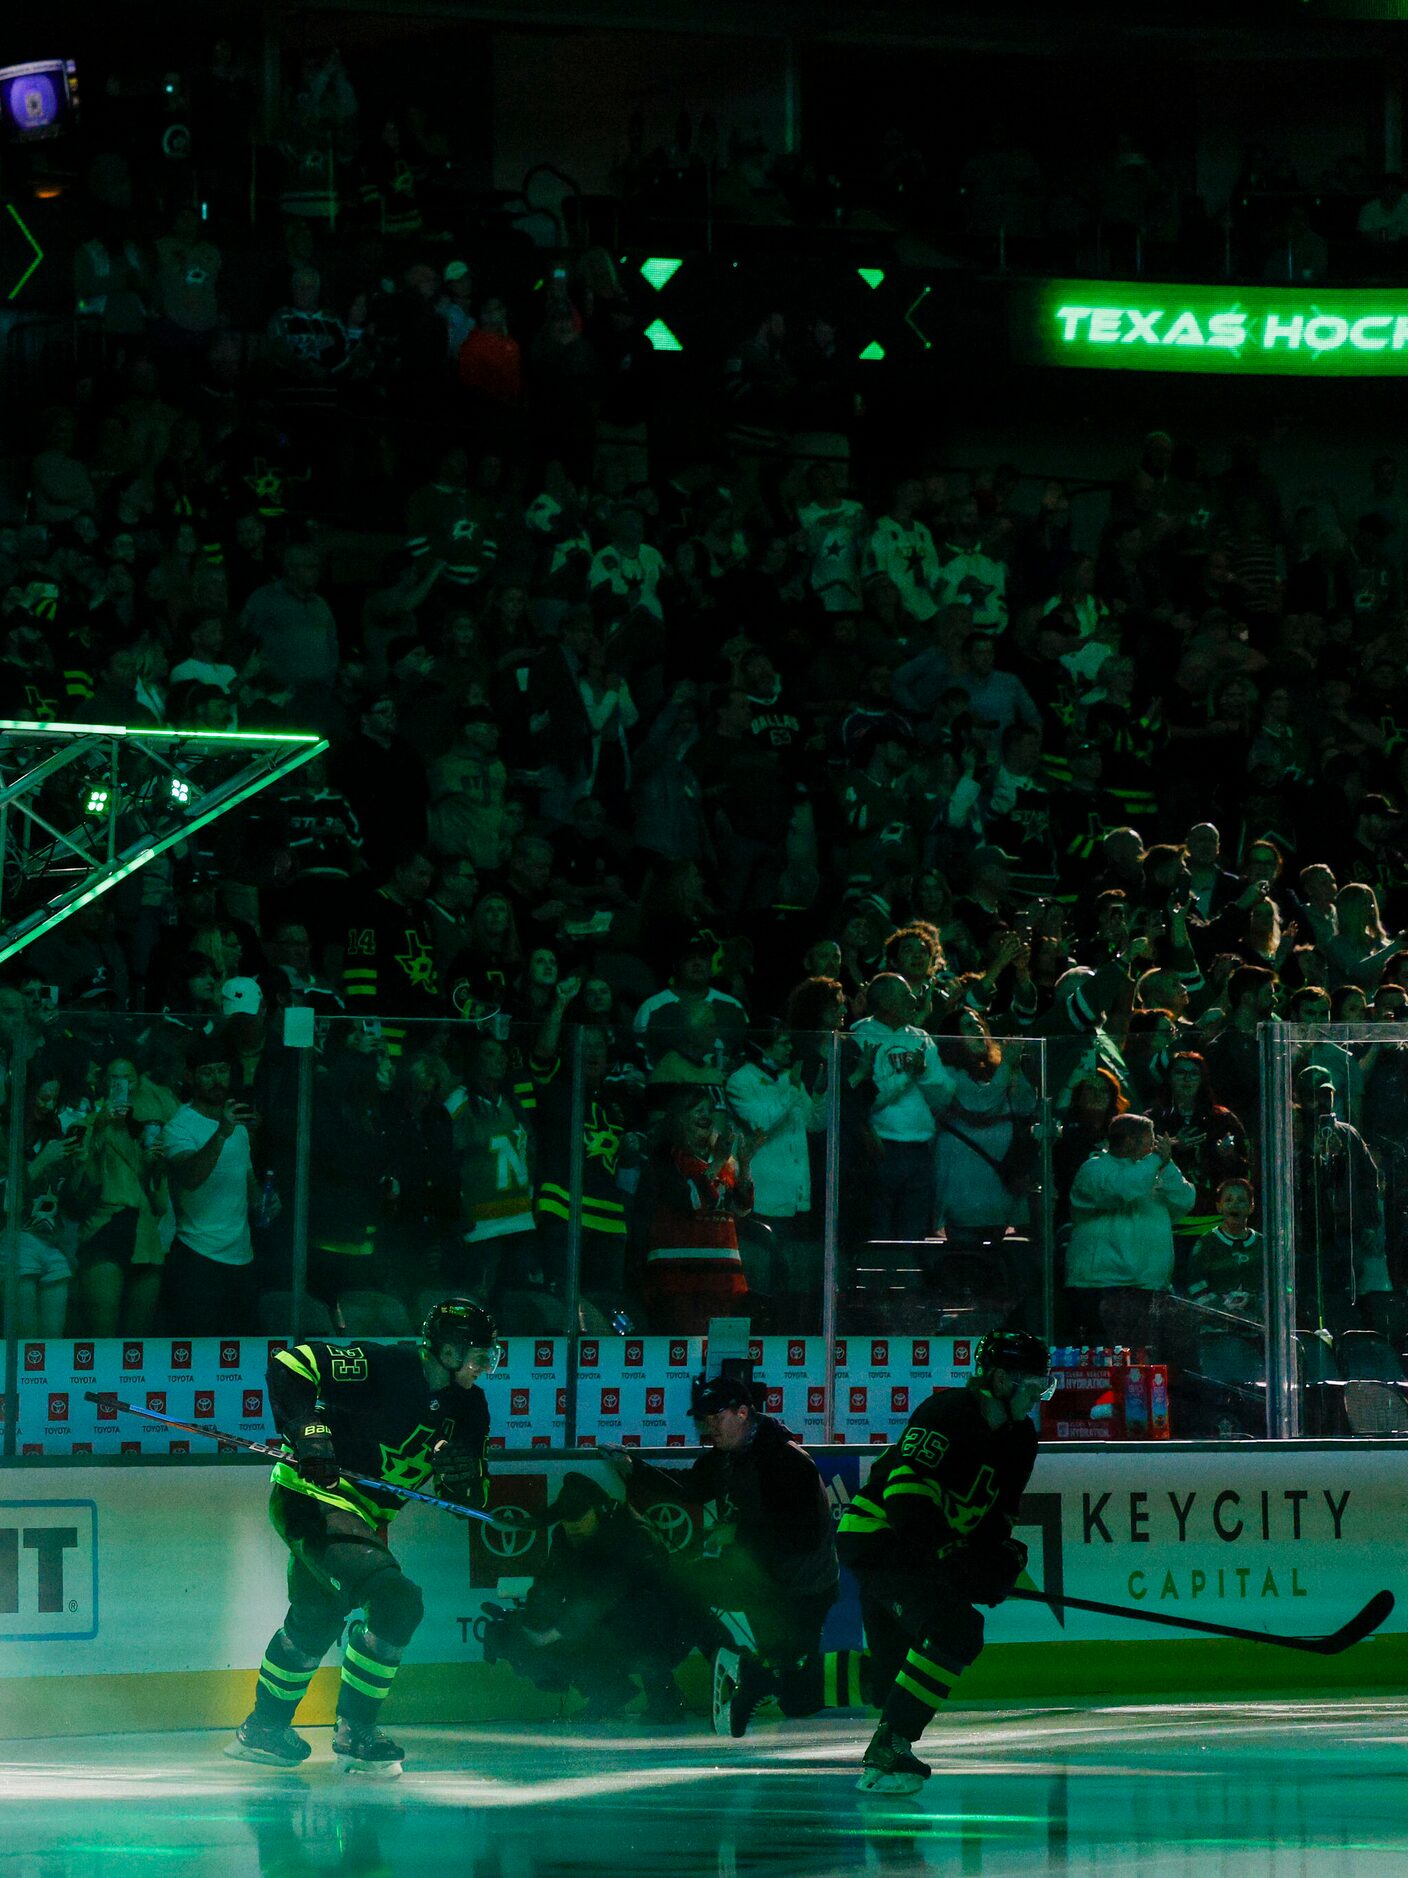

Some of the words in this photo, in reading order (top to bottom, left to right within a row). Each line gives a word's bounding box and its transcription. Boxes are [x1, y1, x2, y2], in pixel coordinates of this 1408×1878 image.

[1056, 306, 1247, 347] TEXAS
[348, 928, 376, 956] 14
[119, 1375, 146, 1383] TOYOTA
[168, 1375, 194, 1383] TOYOTA
[216, 1374, 243, 1382] TOYOTA
[621, 1372, 646, 1380] TOYOTA
[665, 1371, 690, 1379] TOYOTA
[784, 1371, 808, 1379] TOYOTA
[868, 1371, 891, 1379] TOYOTA
[909, 1371, 933, 1379] TOYOTA
[21, 1377, 48, 1385] TOYOTA
[70, 1376, 97, 1384] TOYOTA
[597, 1420, 622, 1428] TOYOTA
[642, 1420, 667, 1428] TOYOTA
[846, 1418, 869, 1426] TOYOTA
[44, 1427, 72, 1435] TOYOTA
[94, 1426, 121, 1434] TOYOTA
[239, 1423, 265, 1431] TOYOTA
[901, 1426, 951, 1468] 25
[1083, 1490, 1352, 1543] KEYCITY
[1127, 1567, 1308, 1600] CAPITAL
